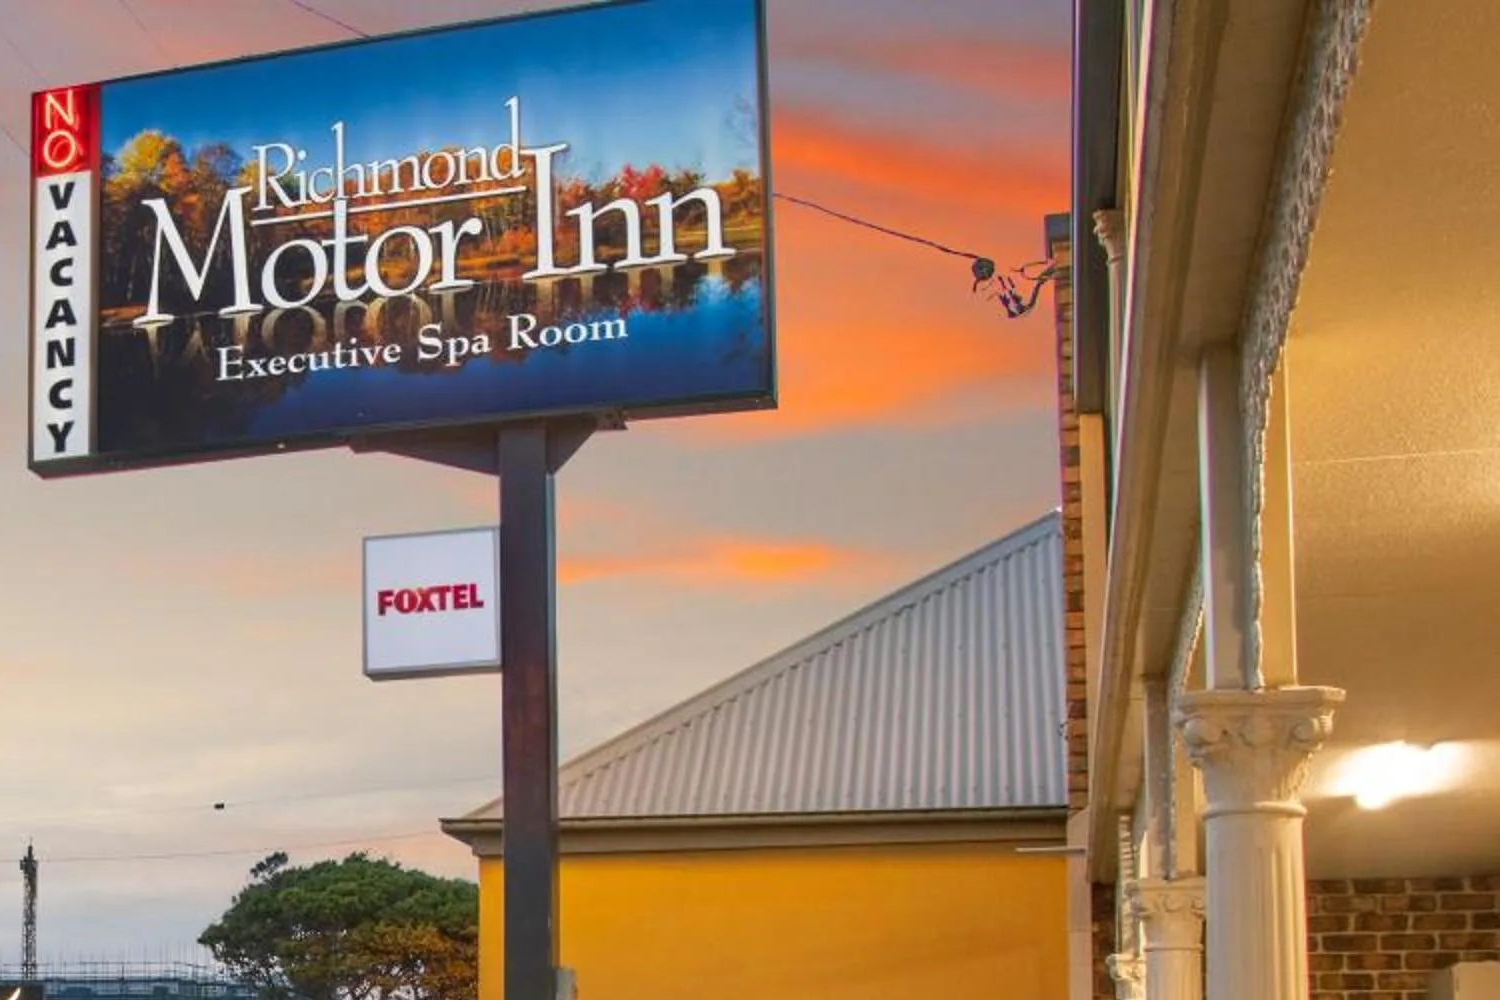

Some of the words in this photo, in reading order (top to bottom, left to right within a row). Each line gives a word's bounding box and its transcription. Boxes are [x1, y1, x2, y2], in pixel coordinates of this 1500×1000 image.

[43, 90, 76, 168] NO
[253, 96, 525, 211] Richmond
[133, 185, 482, 328] Motor
[520, 143, 736, 281] Inn
[45, 182, 77, 453] VACANCY
[216, 338, 401, 381] Executive
[417, 323, 491, 366] Spa
[506, 313, 628, 350] Room
[378, 584, 484, 616] FOXTEL
